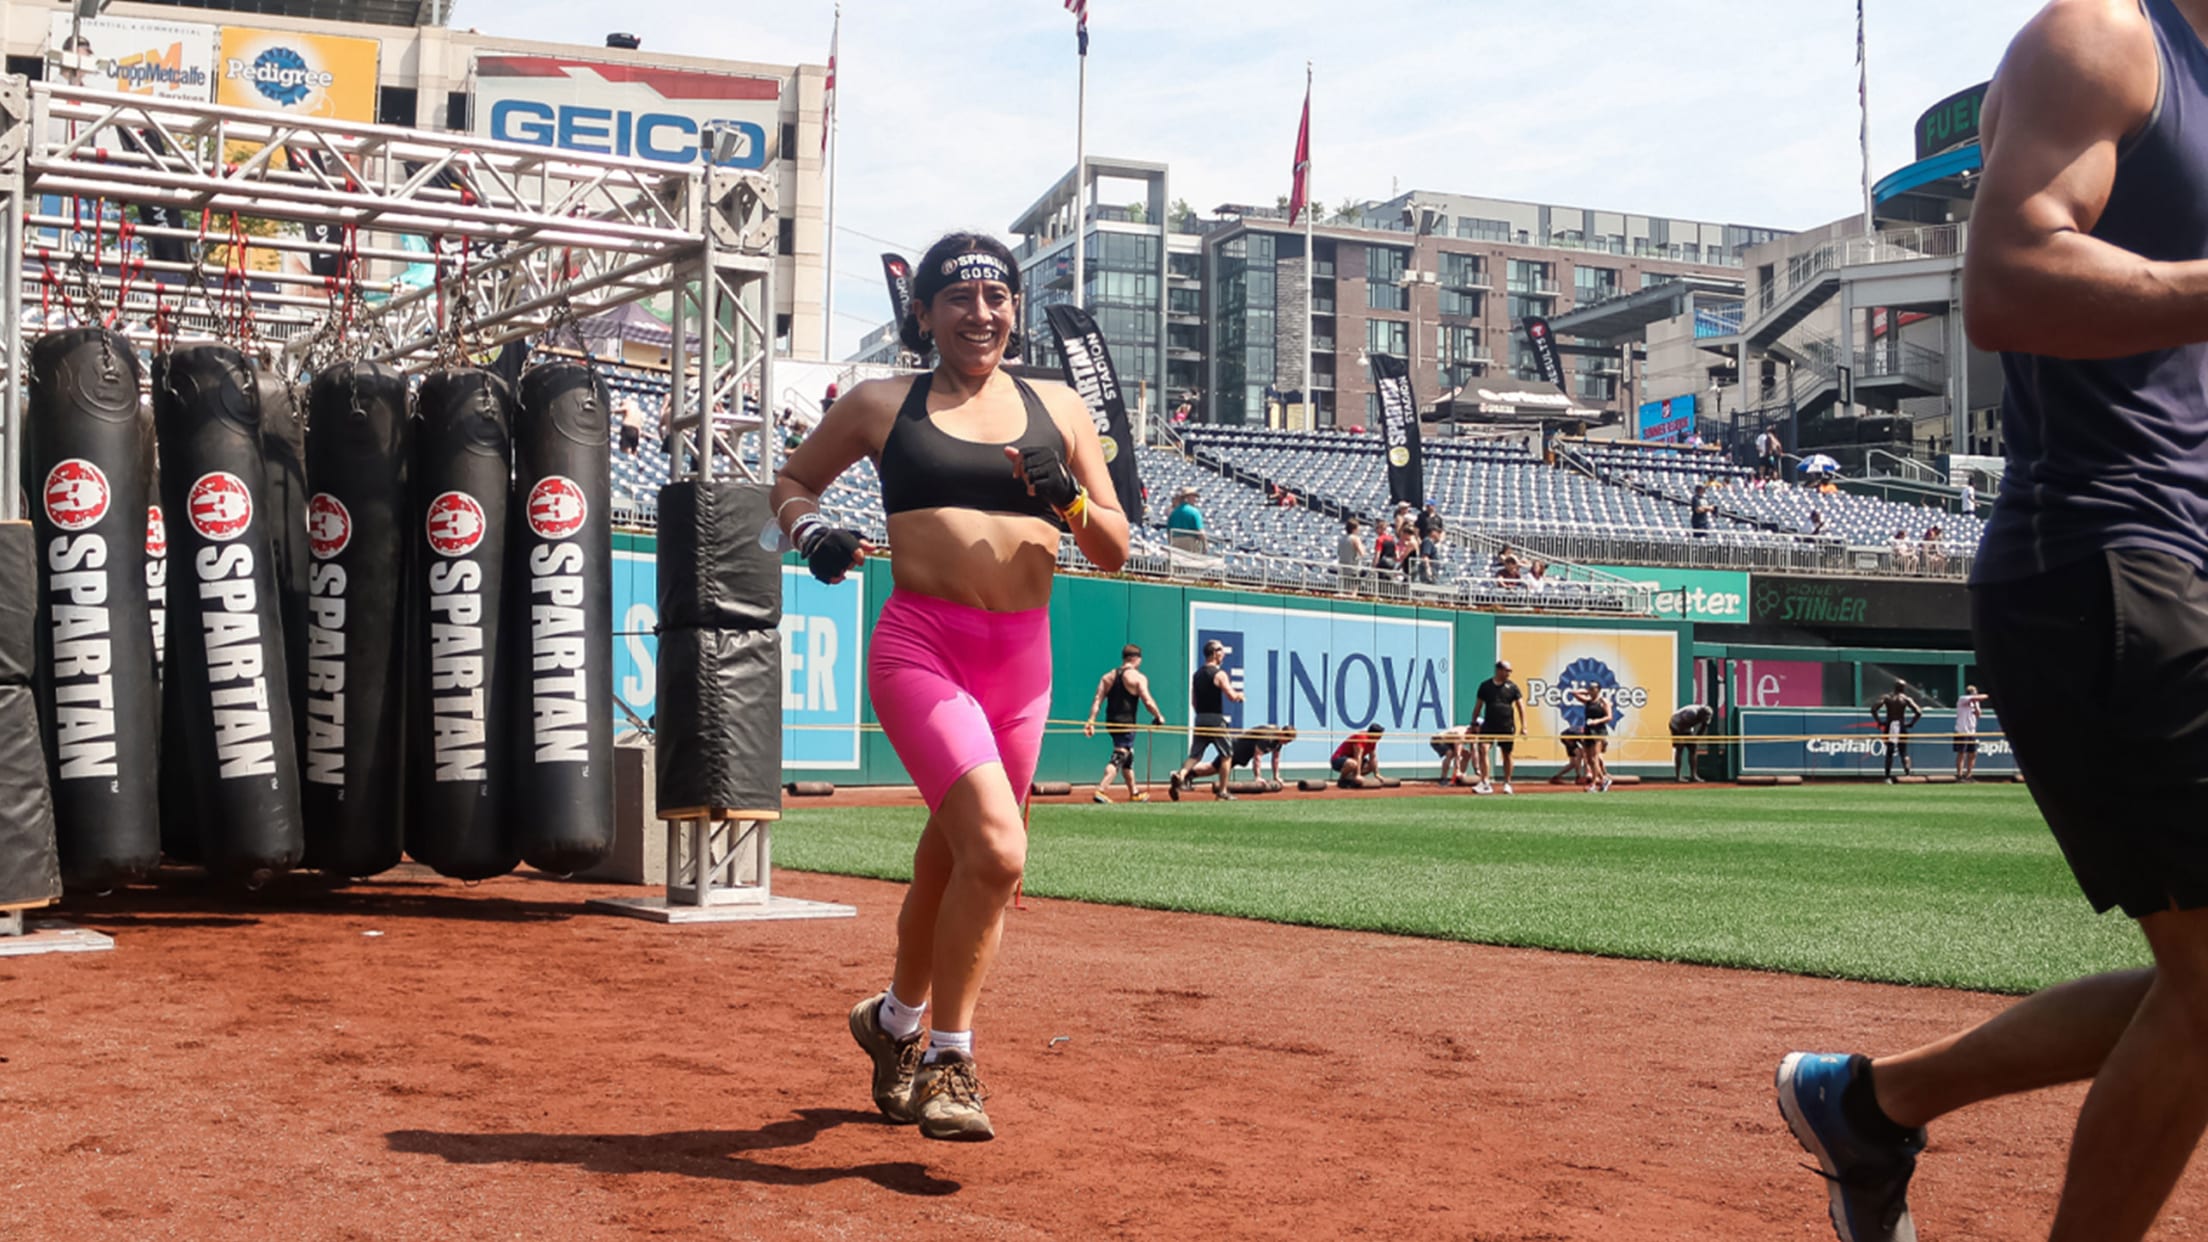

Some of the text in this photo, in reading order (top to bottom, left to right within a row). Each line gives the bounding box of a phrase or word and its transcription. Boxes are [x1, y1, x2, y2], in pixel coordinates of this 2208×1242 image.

[107, 58, 205, 86] CroppMetcalfe
[227, 58, 333, 87] Pedigree
[491, 99, 766, 168] GEICO
[960, 266, 1000, 280] 6057
[1086, 332, 1117, 401] STADION
[1780, 596, 1868, 622] STINGER
[48, 532, 118, 779] SPARTAN
[195, 543, 276, 779] SPARTAN
[306, 562, 347, 785] SPARTAN
[428, 560, 487, 783] SPARTAN
[529, 542, 589, 763] SPARTAN
[1268, 649, 1447, 730] INOVA
